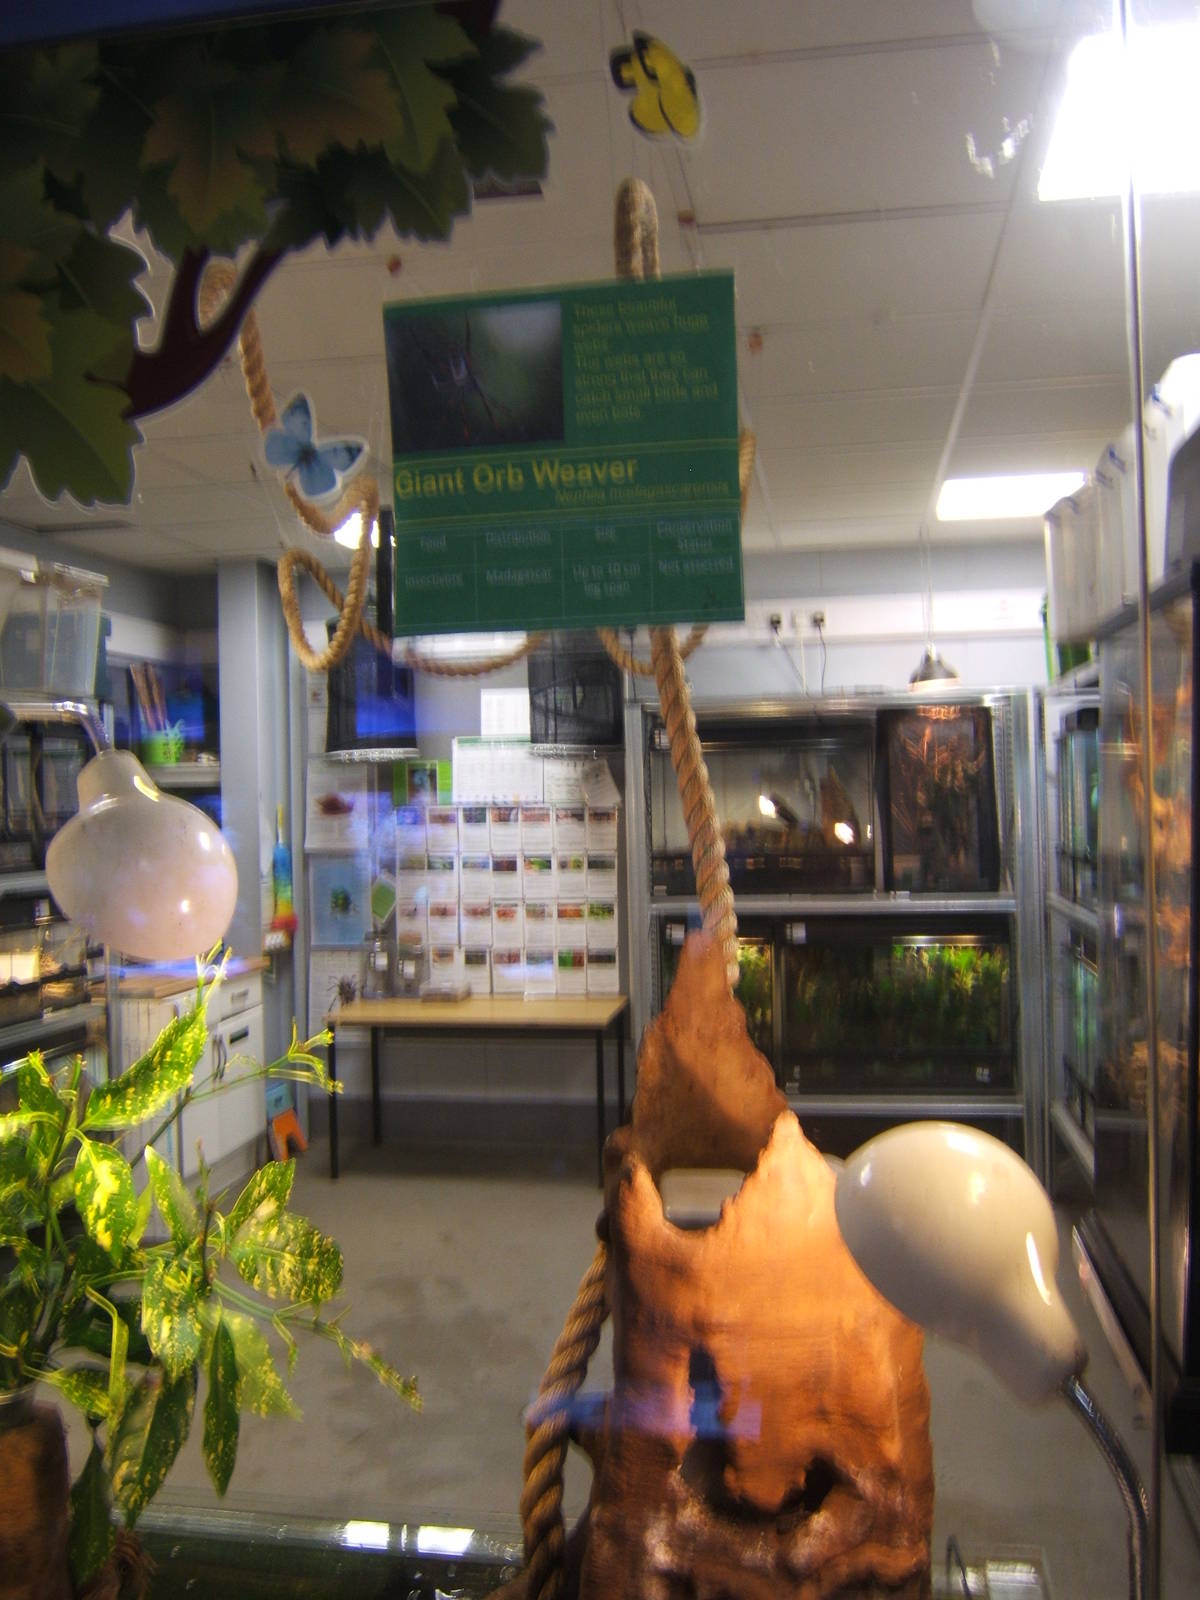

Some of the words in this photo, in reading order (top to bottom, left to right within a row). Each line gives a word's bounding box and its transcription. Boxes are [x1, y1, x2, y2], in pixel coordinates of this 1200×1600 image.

[395, 467, 465, 500] Giant
[472, 460, 524, 493] Orb
[531, 458, 638, 490] Weaver
[486, 567, 552, 586] Madagascar
